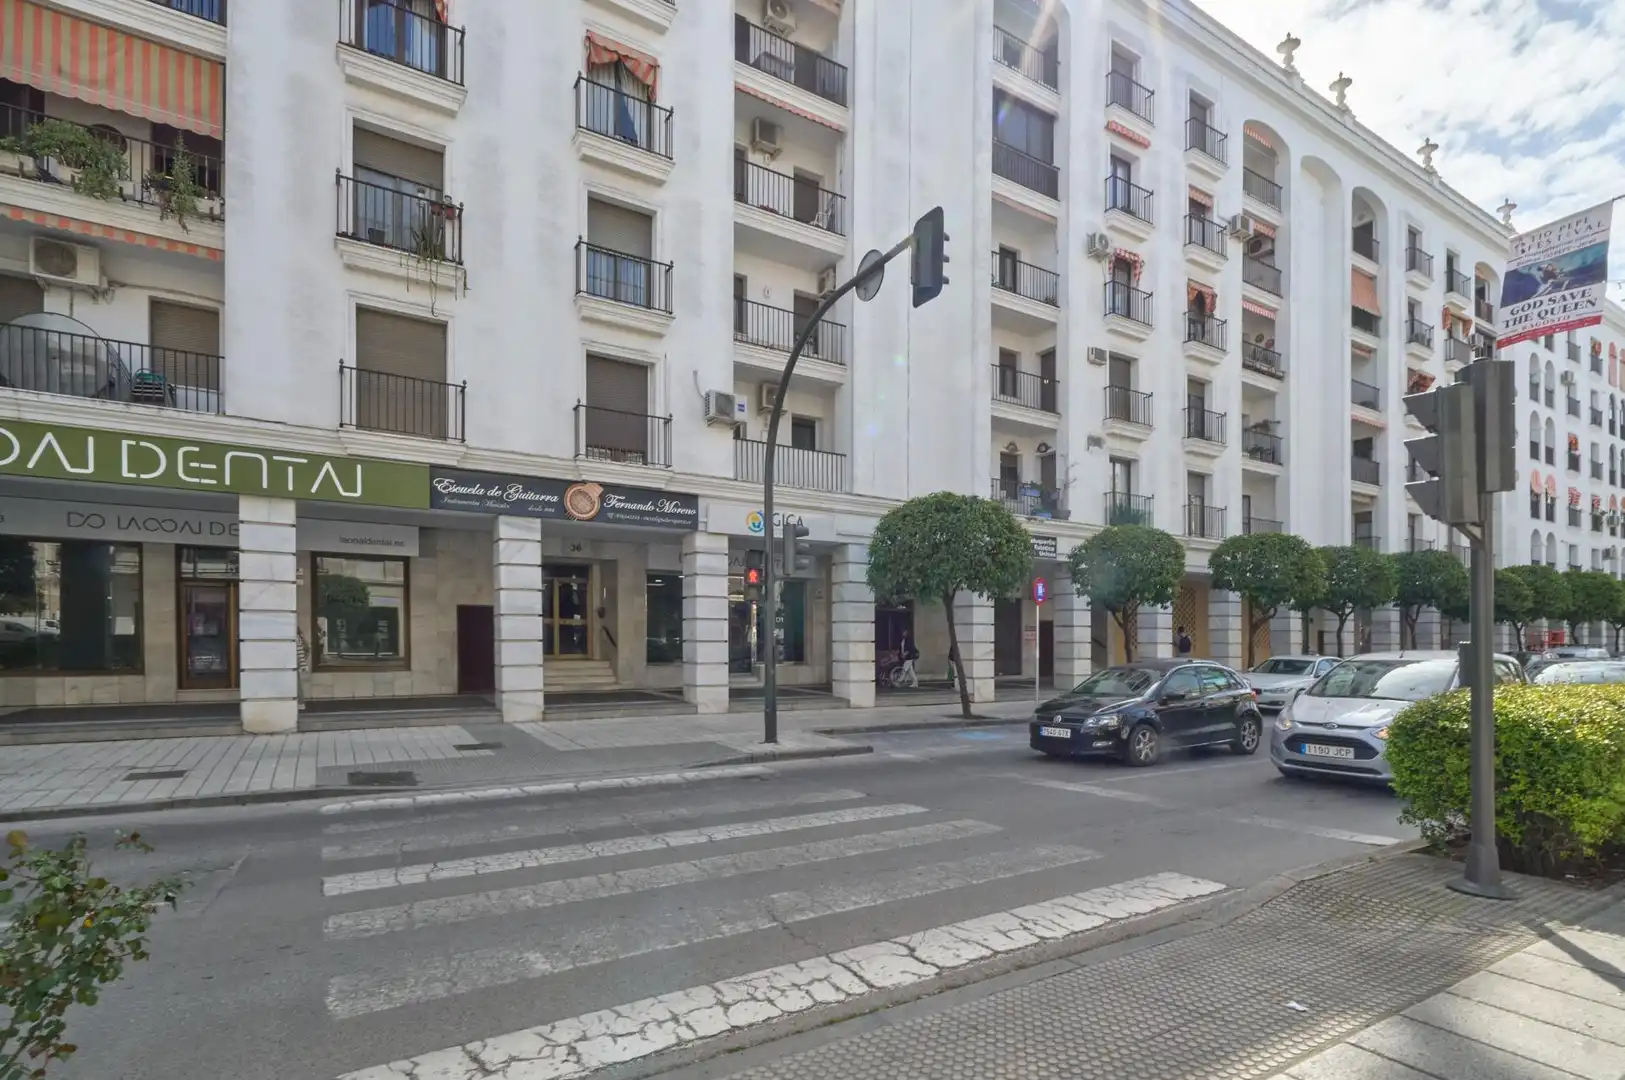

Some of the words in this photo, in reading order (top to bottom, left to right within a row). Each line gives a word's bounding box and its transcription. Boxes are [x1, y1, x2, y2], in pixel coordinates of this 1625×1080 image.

[1502, 313, 1533, 329] THE
[1537, 298, 1598, 320] QUEEN
[1510, 299, 1543, 316] GOD
[1547, 288, 1592, 306] SAVE
[121, 439, 362, 497] DENTAL
[433, 477, 486, 494] Escuela
[487, 486, 502, 497] de
[503, 483, 559, 503] Guitarra
[603, 494, 655, 512] Fernando
[656, 498, 696, 516] Moreno
[1334, 747, 1351, 757] JCP
